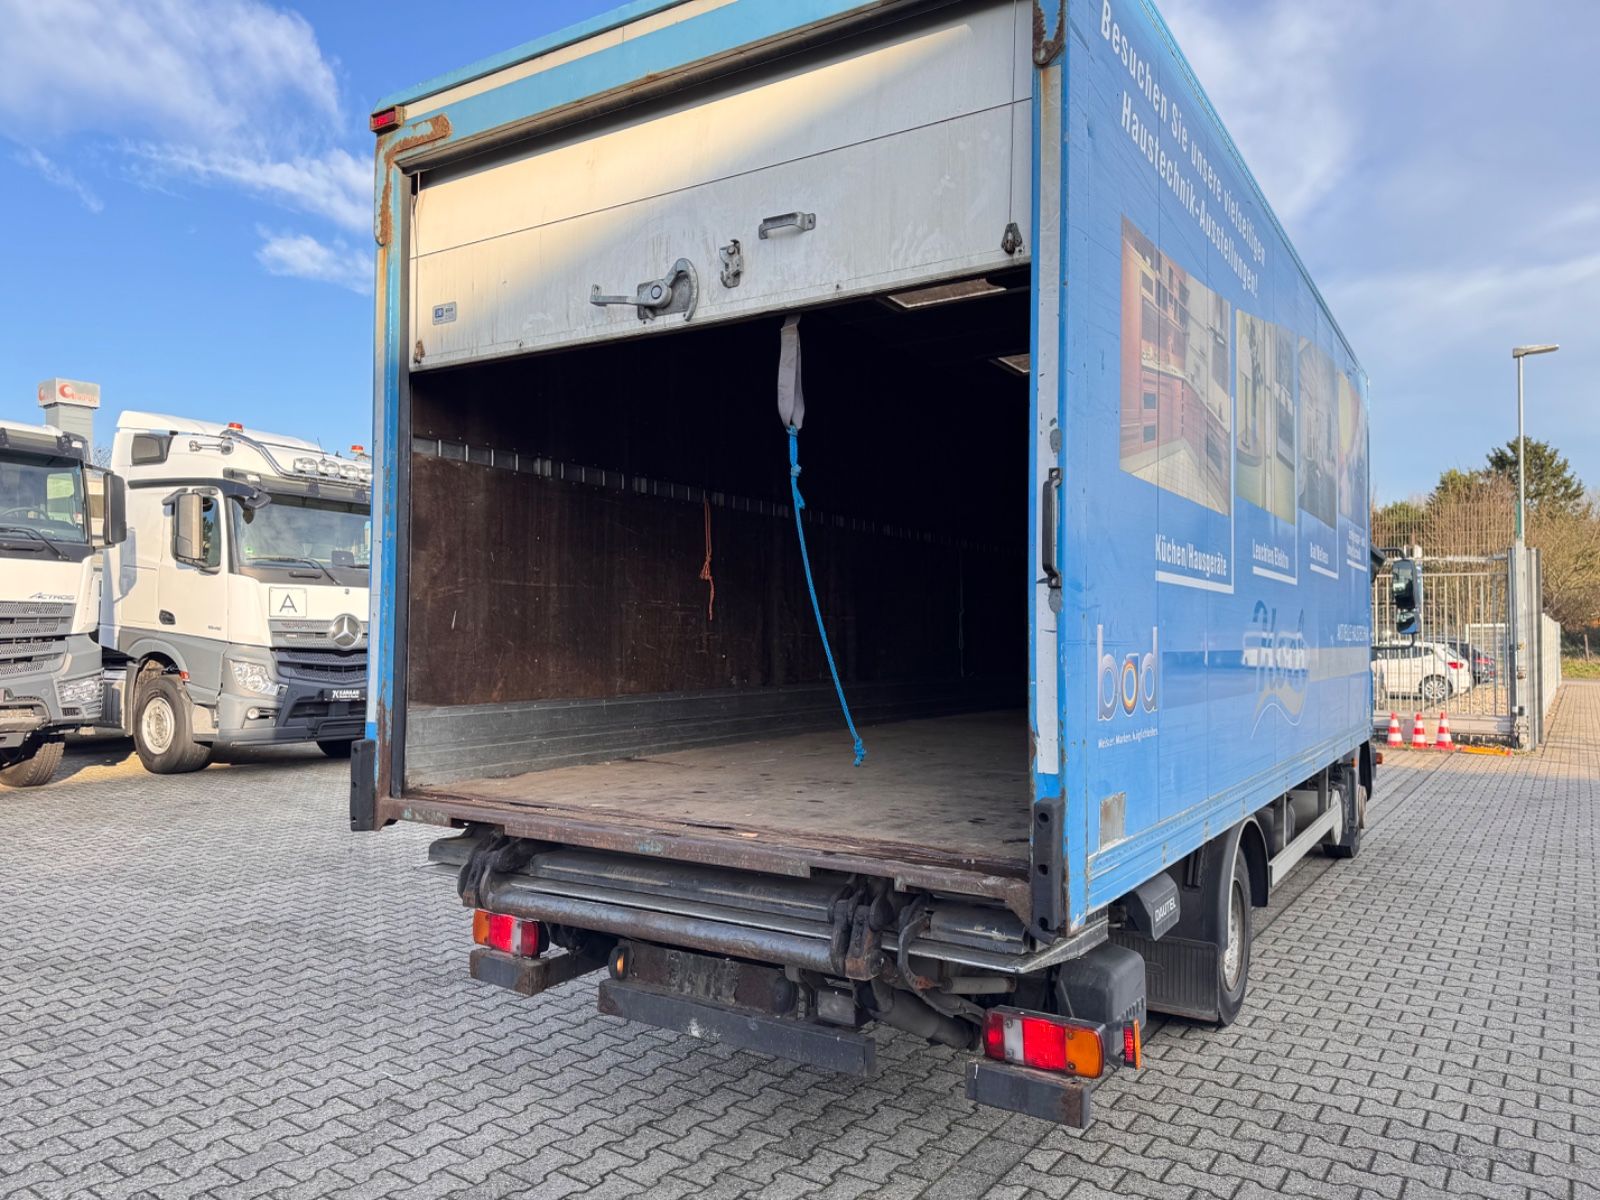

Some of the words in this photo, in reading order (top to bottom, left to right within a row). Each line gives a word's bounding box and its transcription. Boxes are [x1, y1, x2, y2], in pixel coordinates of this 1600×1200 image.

[1101, 0, 1167, 123] Besuchen
[1171, 102, 1188, 153] Sie
[1191, 140, 1222, 203] unsere
[1223, 189, 1266, 267] vielseitigen
[1121, 89, 1259, 298] Haustechnik-Ausstellungen!
[279, 593, 298, 613] A
[1154, 896, 1176, 922] DAUTEL
